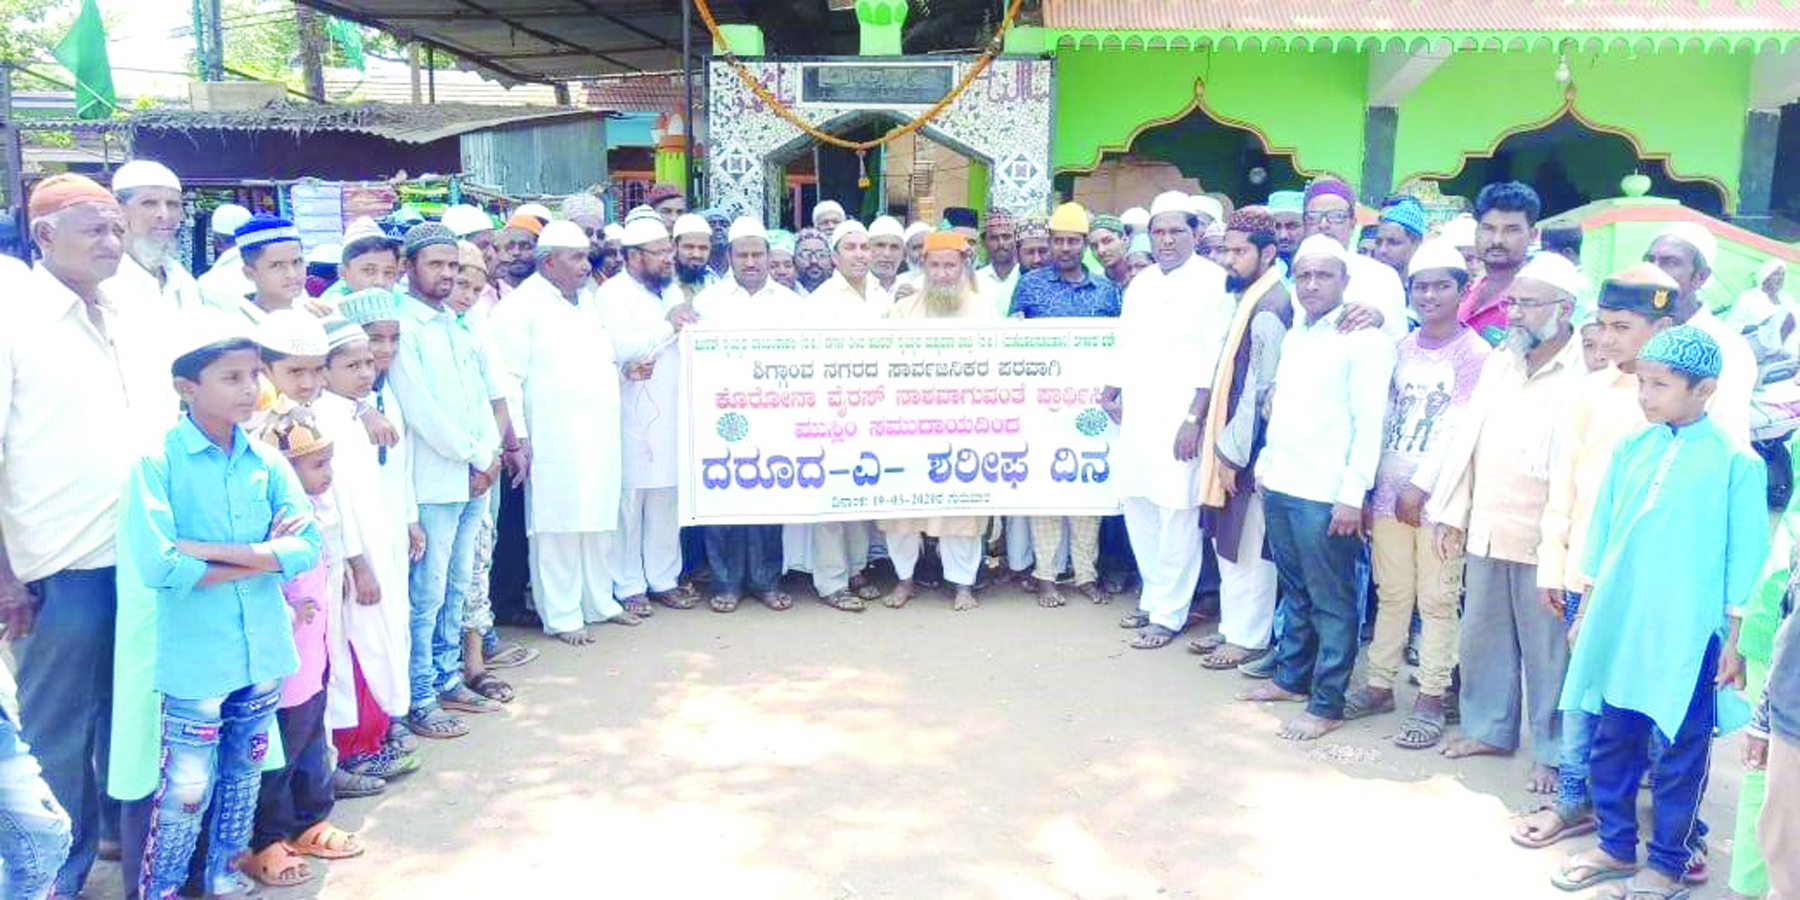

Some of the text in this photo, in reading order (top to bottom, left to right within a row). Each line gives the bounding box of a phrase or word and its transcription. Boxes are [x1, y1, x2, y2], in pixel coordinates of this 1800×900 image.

[823, 359, 879, 379] ನಗರದ
[888, 359, 990, 378] ಸಾರ್ವಜನಿಕರ
[998, 358, 1062, 377] ಪರವಾಗಿ
[827, 384, 886, 418] ವೈರಸ್
[869, 415, 1022, 437] ಸಮುದಾಯದಿಂದ
[1050, 440, 1111, 484] ದಿನ
